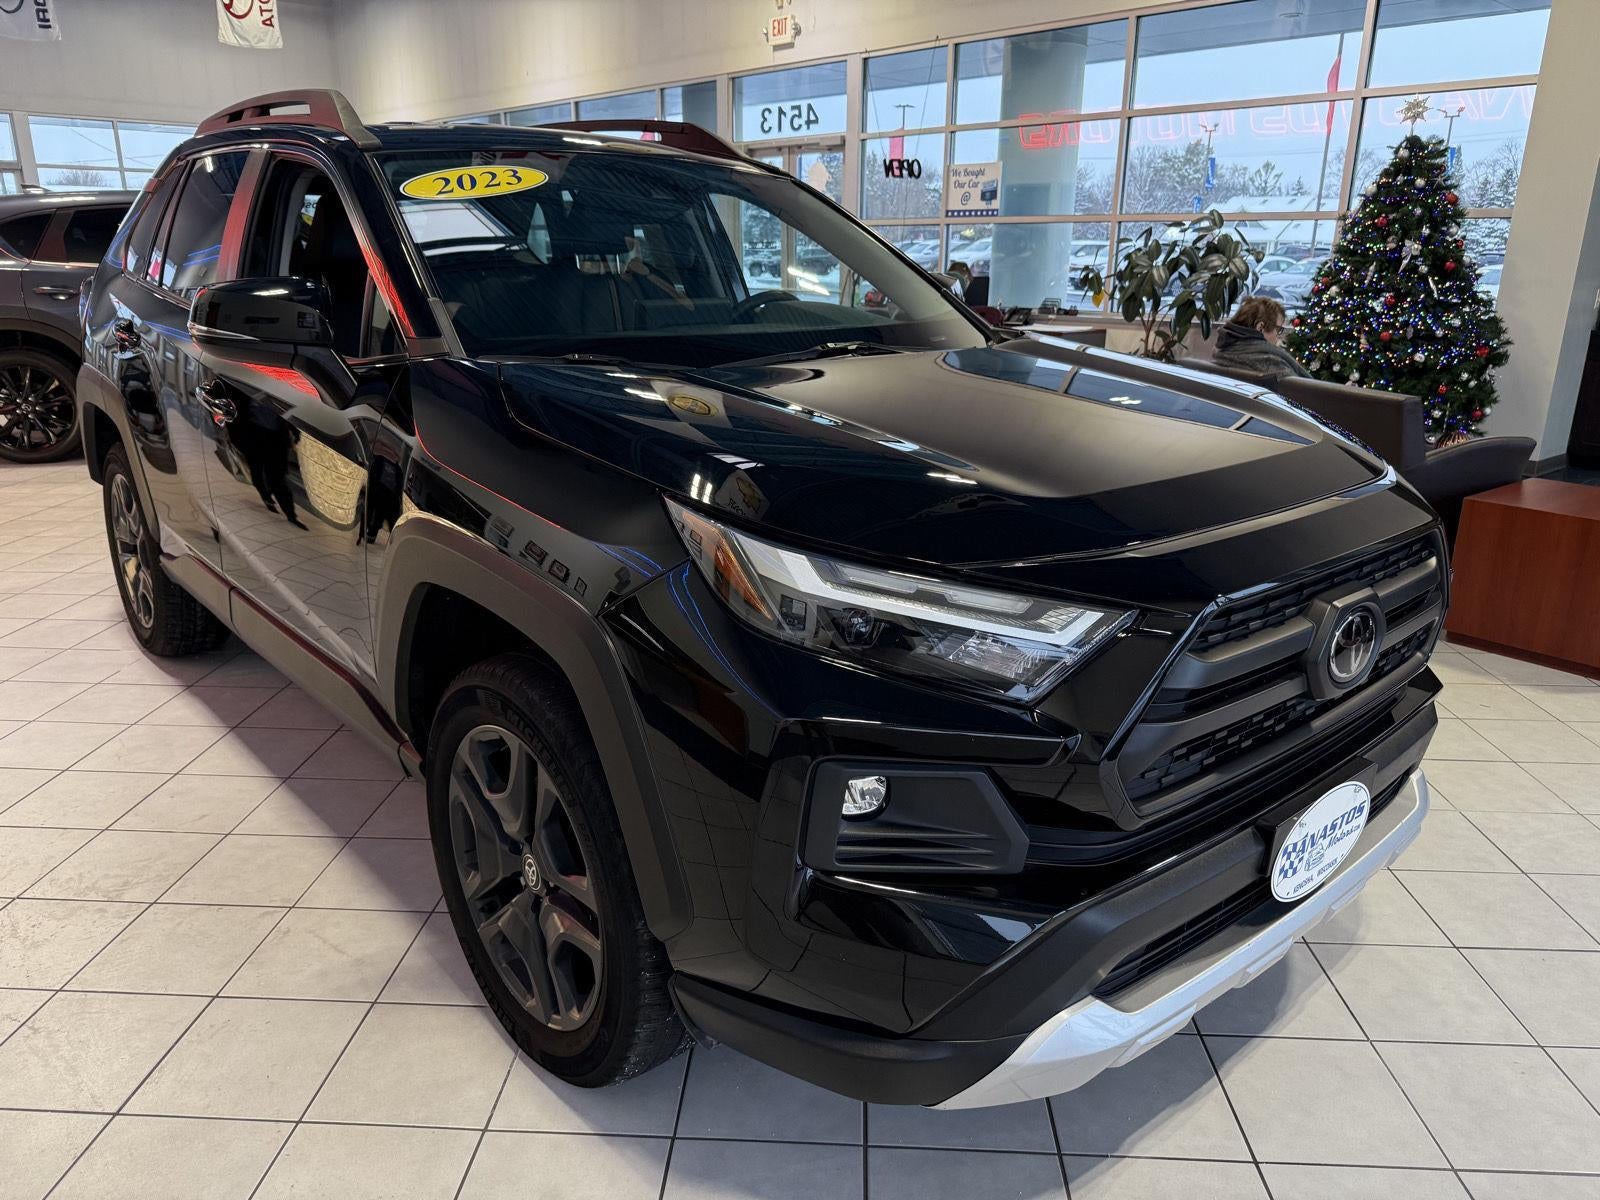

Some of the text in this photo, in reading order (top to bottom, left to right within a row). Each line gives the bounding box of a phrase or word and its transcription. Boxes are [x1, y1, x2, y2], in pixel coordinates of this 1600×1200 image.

[772, 17, 789, 38] EXIT
[432, 169, 523, 196] 2023
[951, 167, 986, 179] We Bought
[953, 178, 981, 189] Our Car
[1295, 800, 1367, 859] ANASTOS
